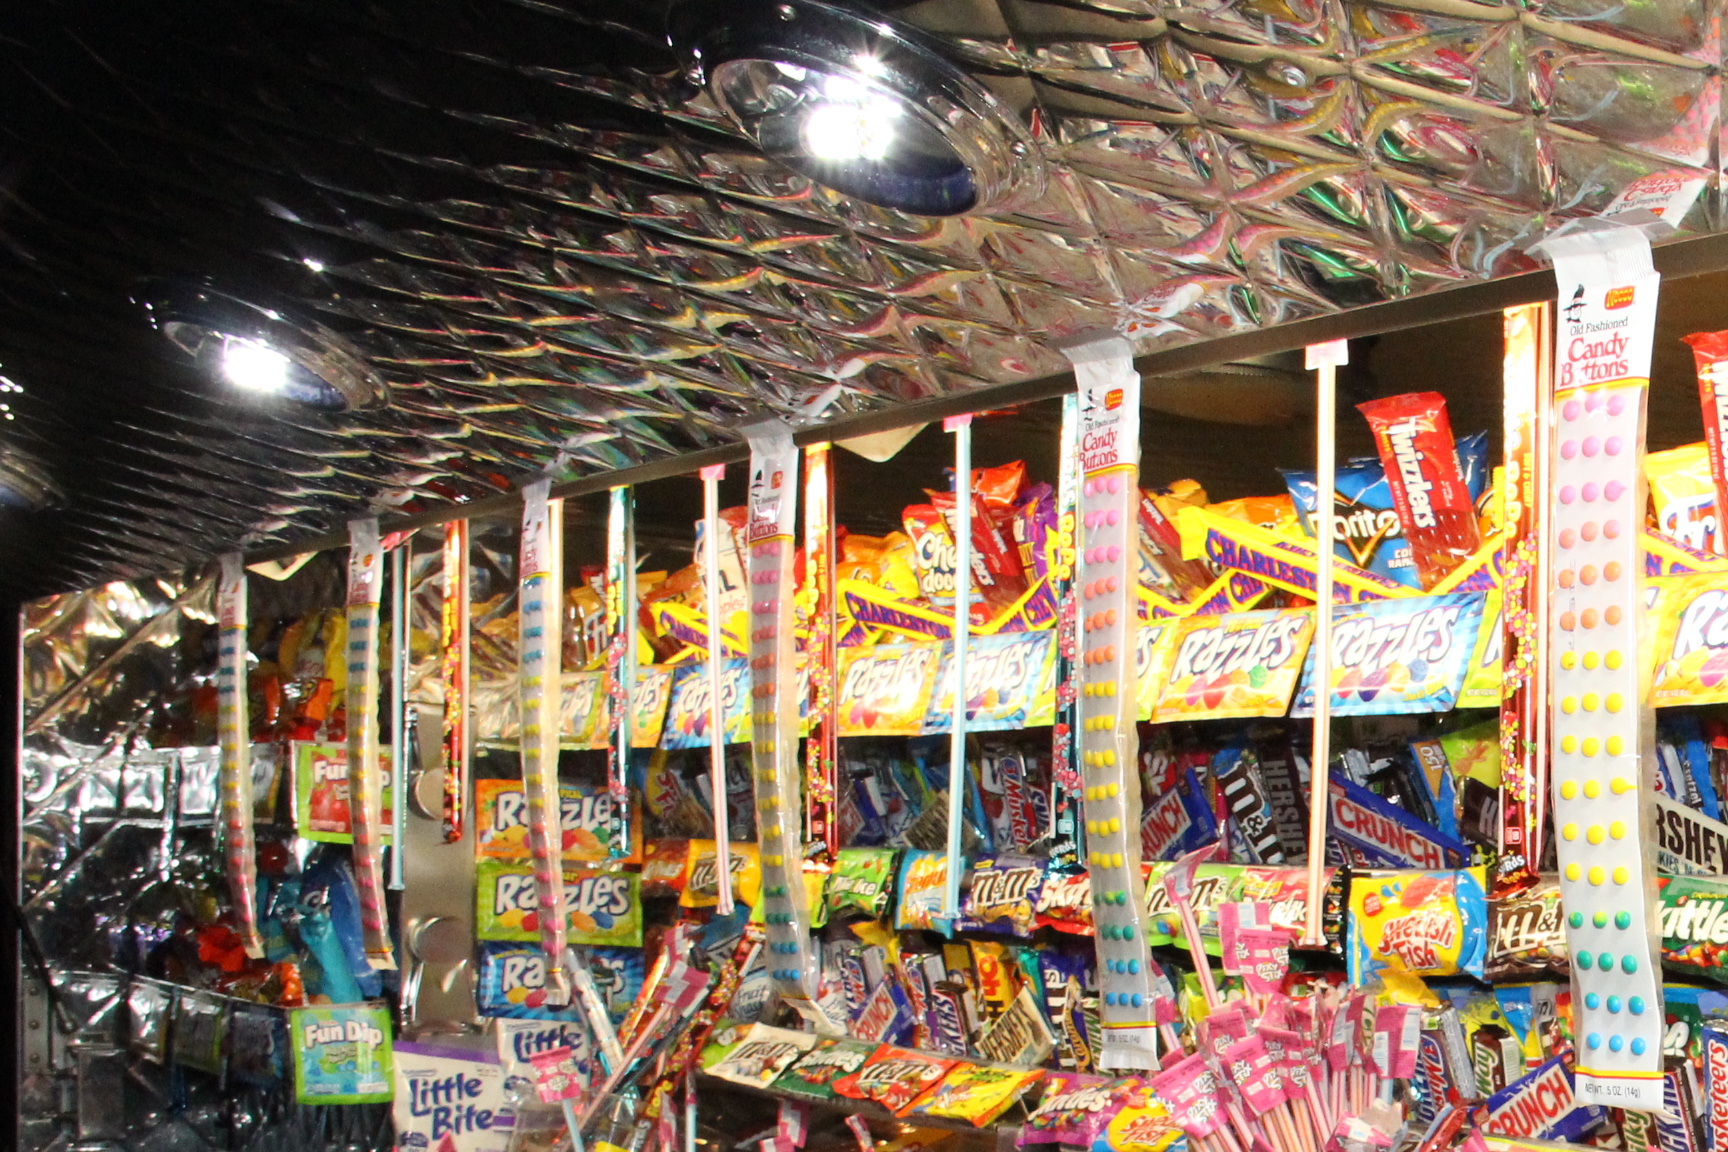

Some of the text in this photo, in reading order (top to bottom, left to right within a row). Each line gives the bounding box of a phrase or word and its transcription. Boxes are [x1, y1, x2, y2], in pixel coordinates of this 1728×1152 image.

[1605, 285, 1636, 310] Necco
[1570, 317, 1628, 336] Old Fashioned
[1568, 331, 1630, 362] Candy
[1081, 429, 1119, 453] Candy
[1389, 414, 1436, 530] Twizzlers
[1171, 614, 1301, 684] Razzles
[1334, 794, 1445, 869] CRUNCH
[1398, 943, 1437, 971] Fish
[304, 1023, 383, 1048] Fun Dip
[409, 1071, 483, 1117] Little
